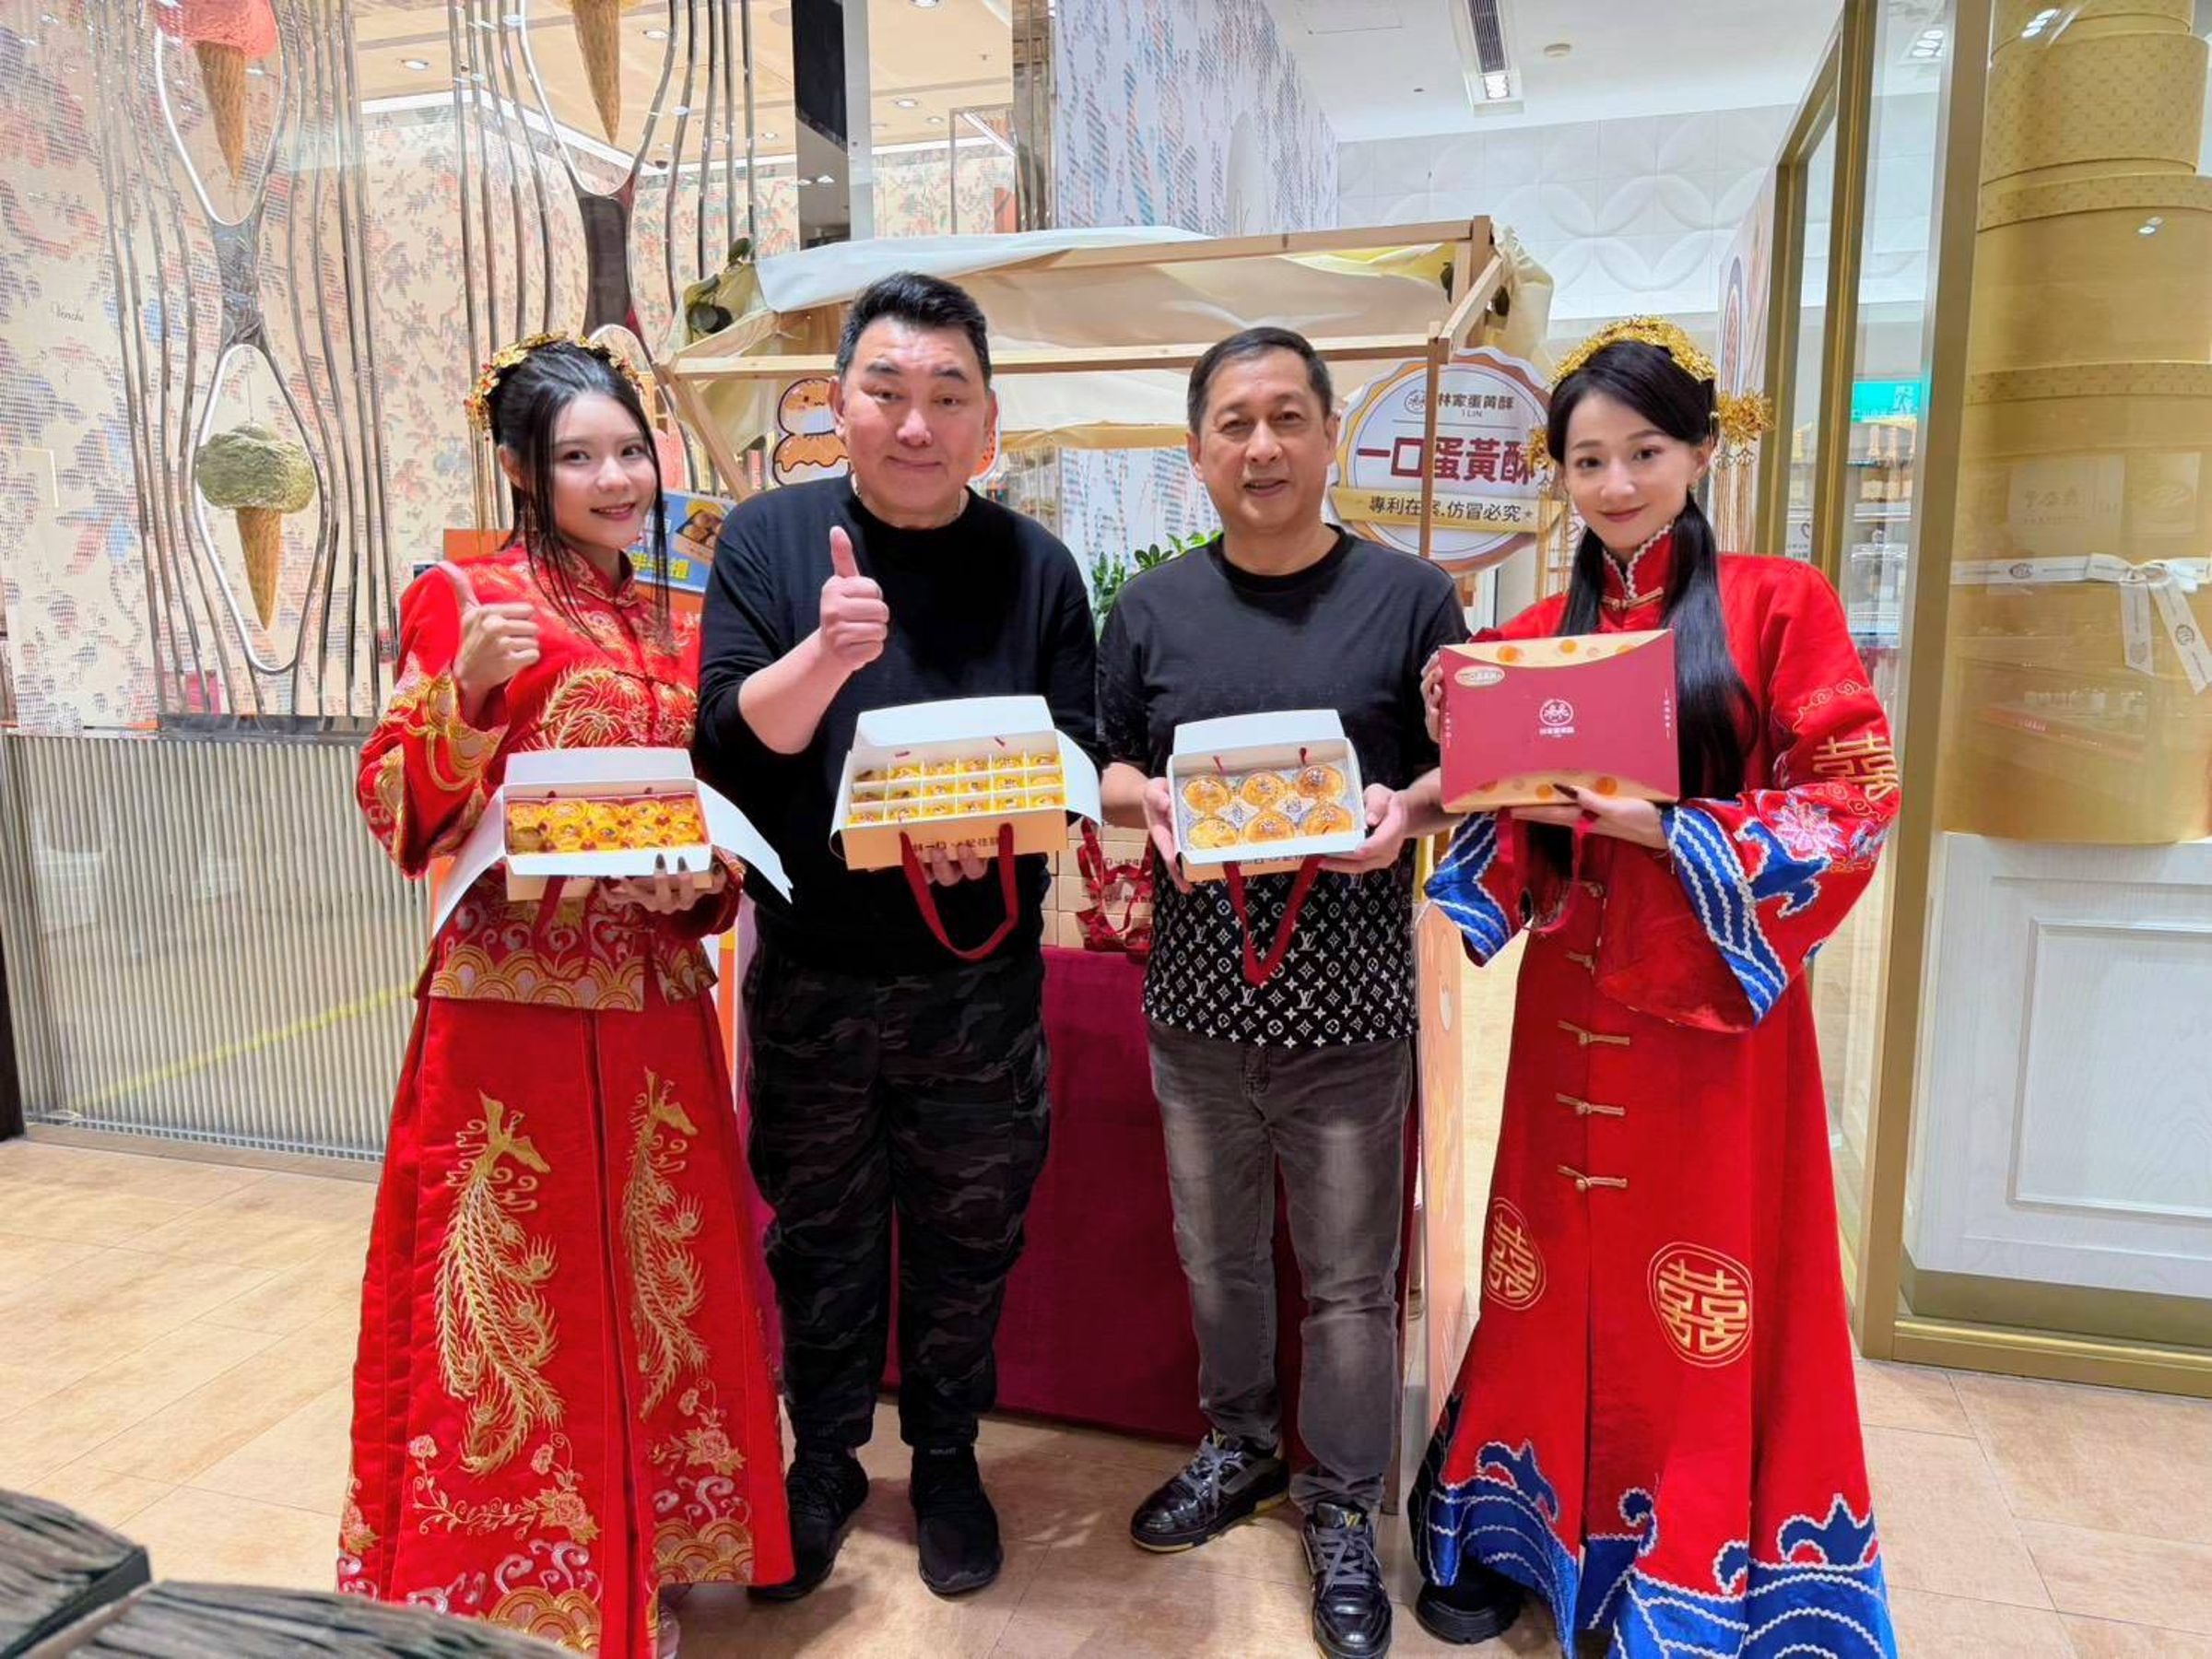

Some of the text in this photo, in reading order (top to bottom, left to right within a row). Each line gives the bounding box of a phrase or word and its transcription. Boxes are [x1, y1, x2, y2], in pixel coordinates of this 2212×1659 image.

[1357, 436, 1532, 486] 一口蛋黃酥
